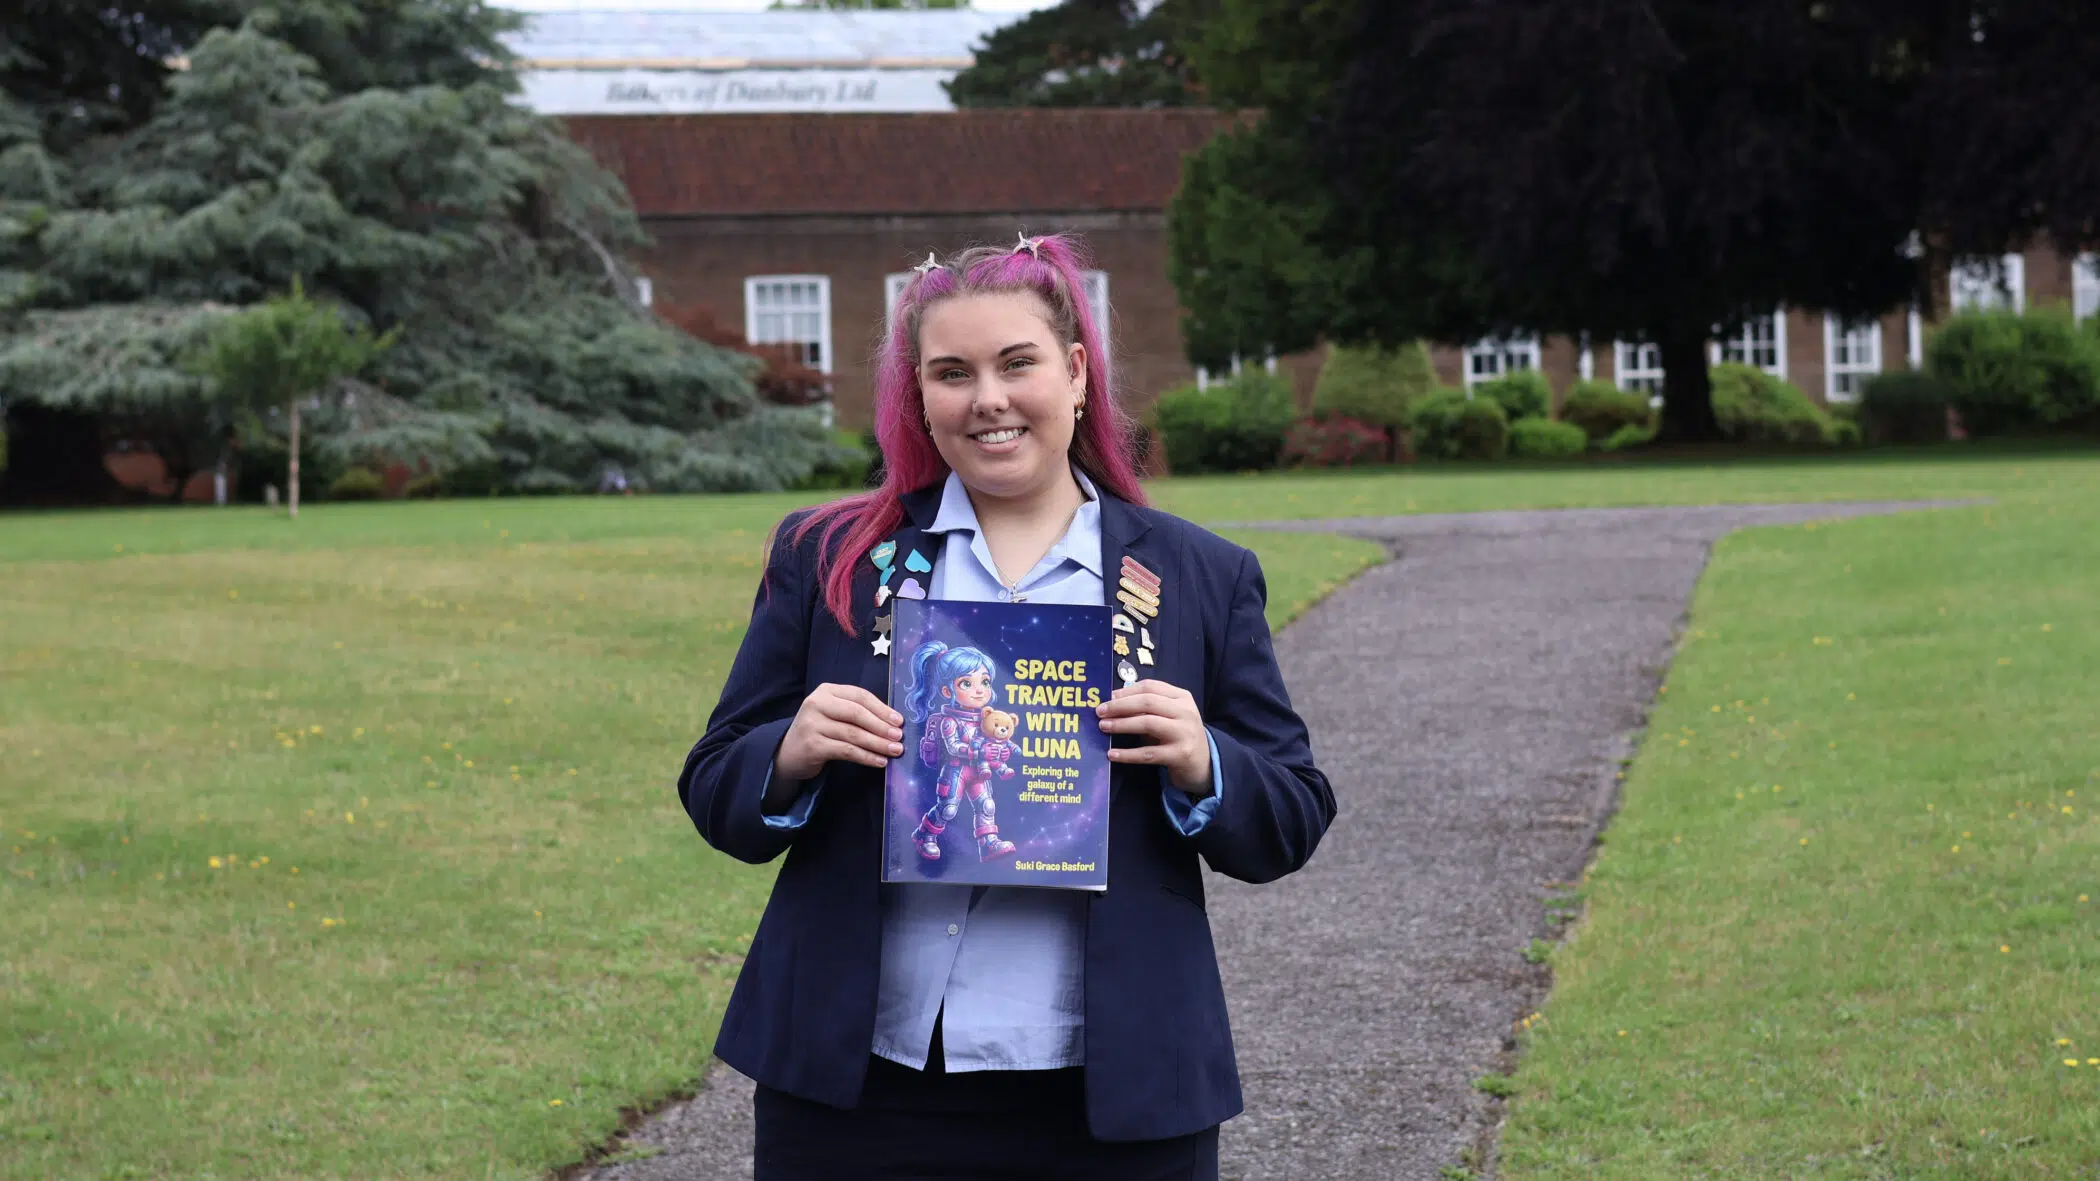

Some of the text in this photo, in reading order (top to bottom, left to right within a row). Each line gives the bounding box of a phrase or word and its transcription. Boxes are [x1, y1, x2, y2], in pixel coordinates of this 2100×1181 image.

[834, 79, 879, 102] Ltd
[1014, 659, 1087, 682] SPACE
[1005, 684, 1100, 708] TRAVELS
[1025, 712, 1079, 733] WITH
[1022, 737, 1081, 760] LUNA
[1022, 765, 1079, 779] Exploring the
[1027, 779, 1074, 792] galaxy of a
[1019, 792, 1081, 804] different mind
[1015, 860, 1034, 871] Suki
[1061, 861, 1095, 872] Basford
